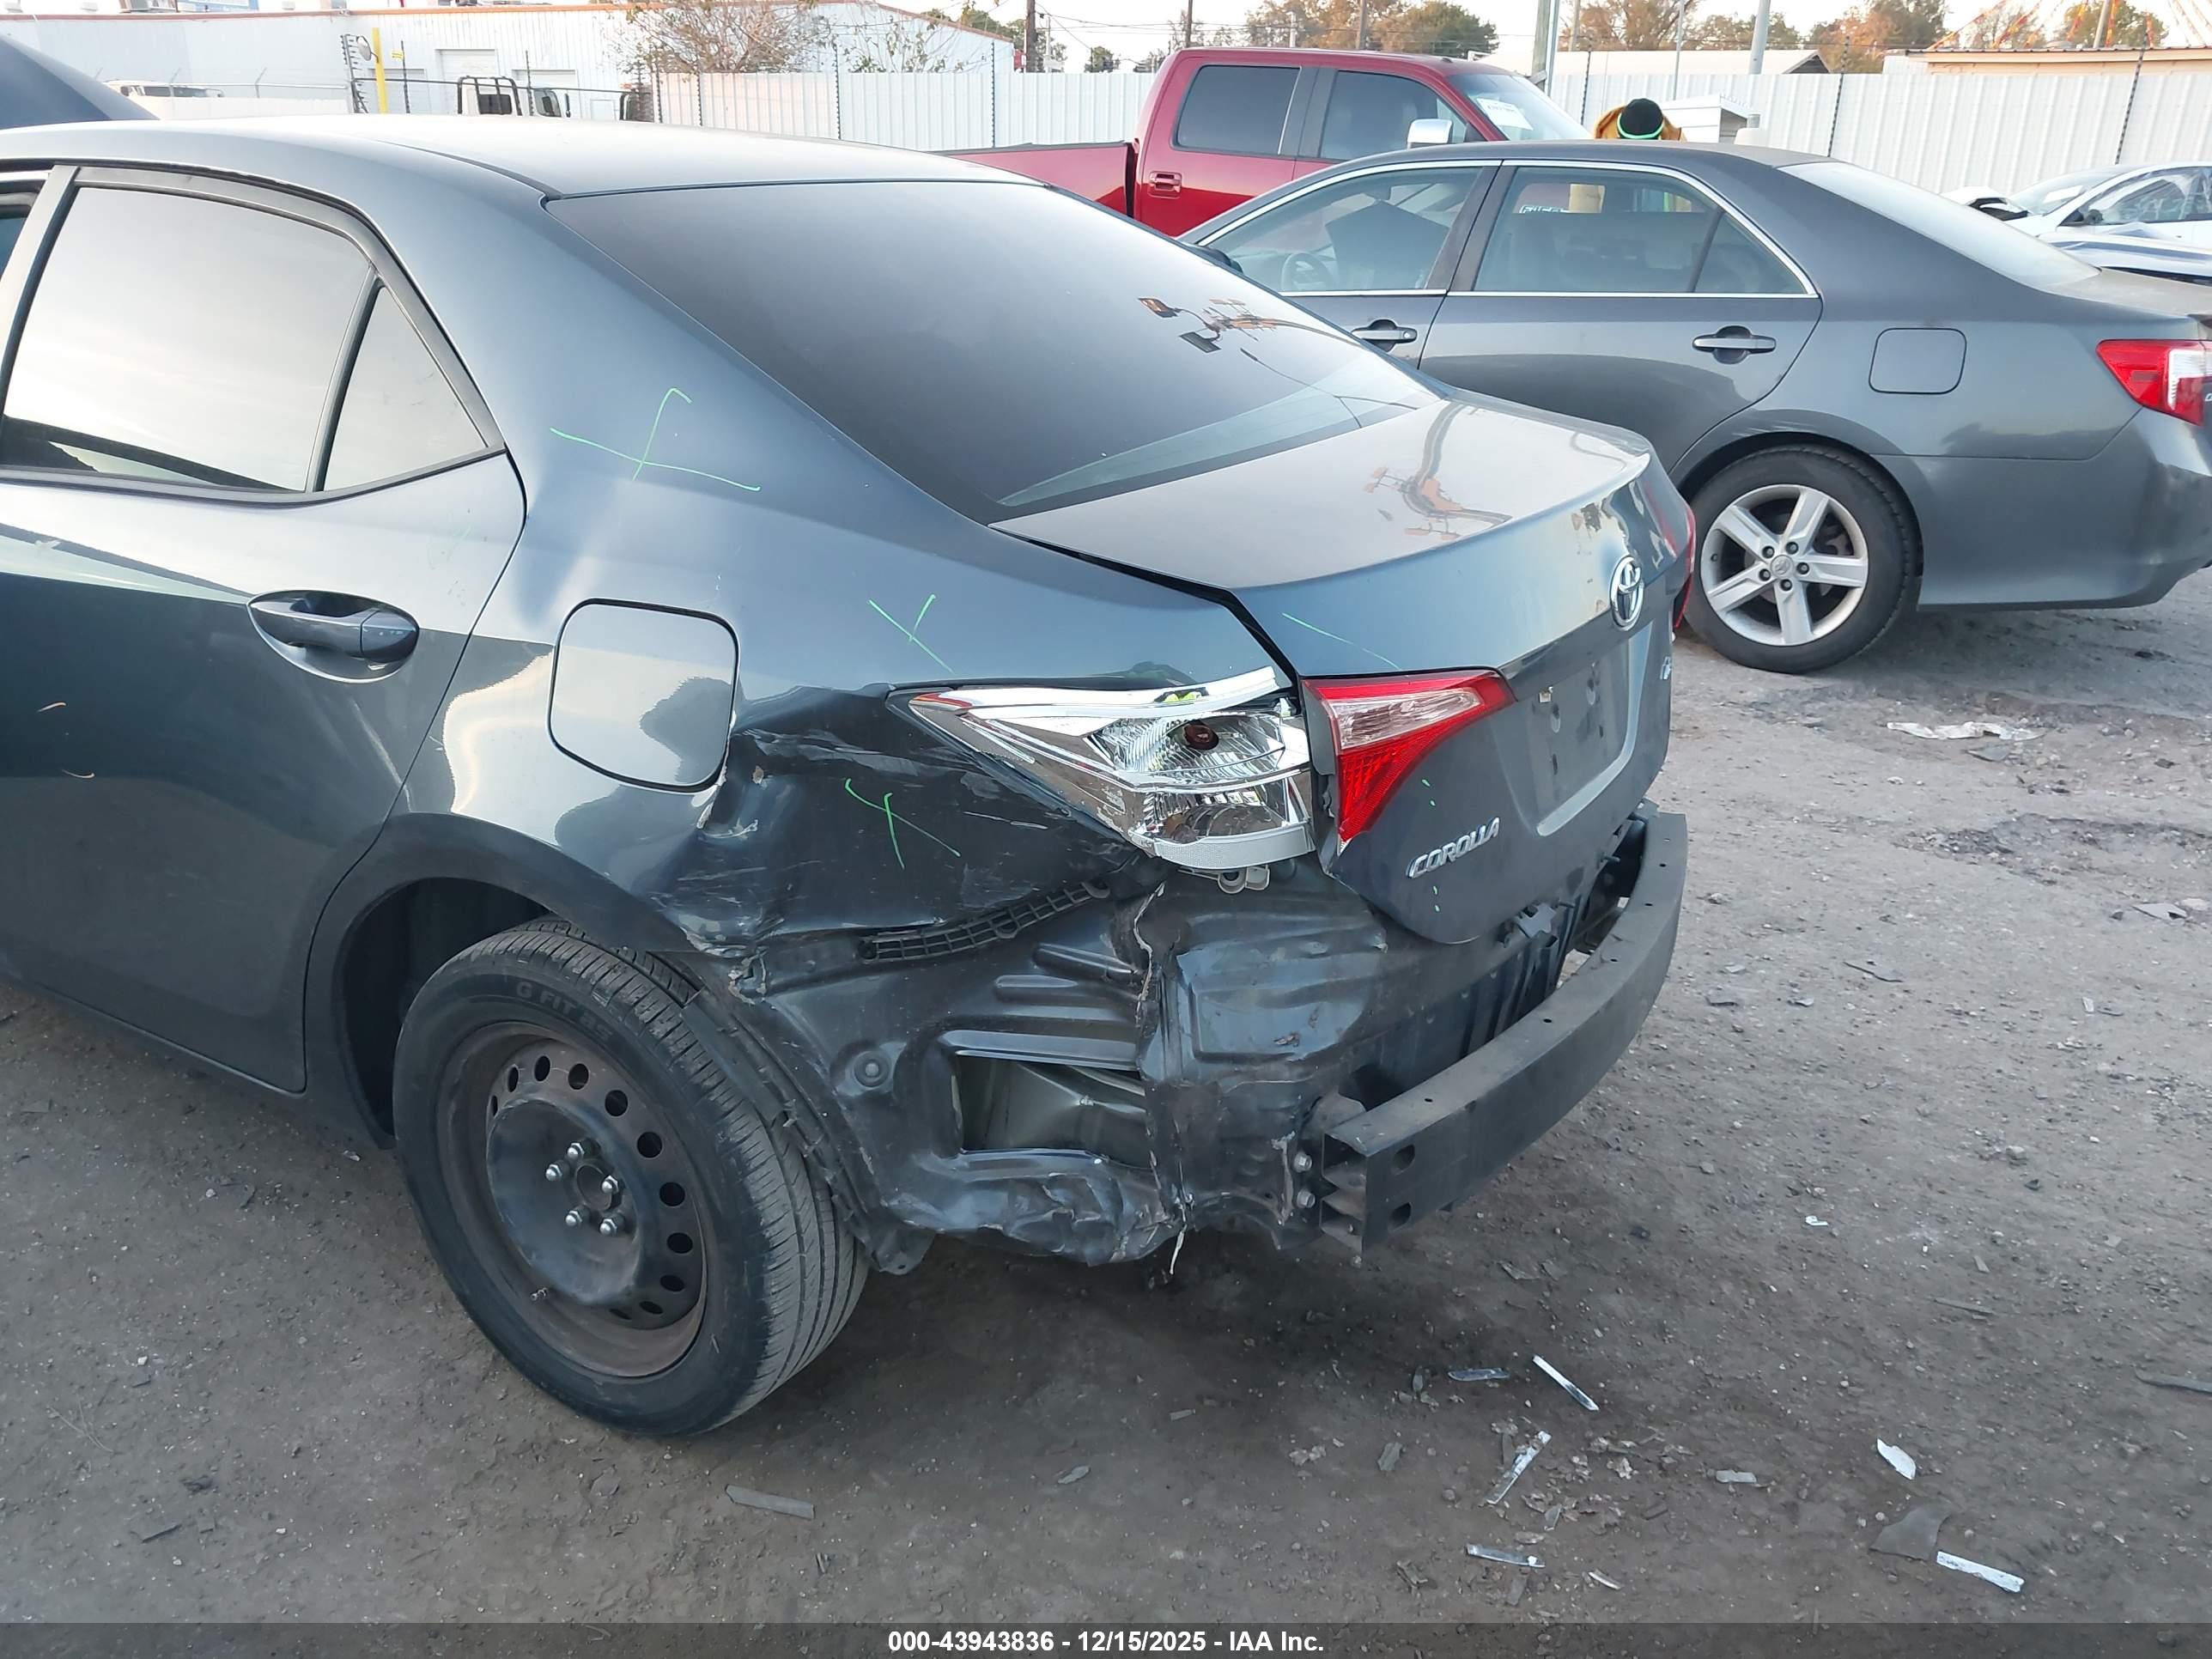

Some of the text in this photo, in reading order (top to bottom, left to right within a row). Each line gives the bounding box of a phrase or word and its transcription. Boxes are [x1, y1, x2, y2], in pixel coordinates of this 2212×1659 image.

[1406, 817, 1500, 878] COROLLA
[516, 981, 532, 998] G
[540, 990, 577, 1014] FIT
